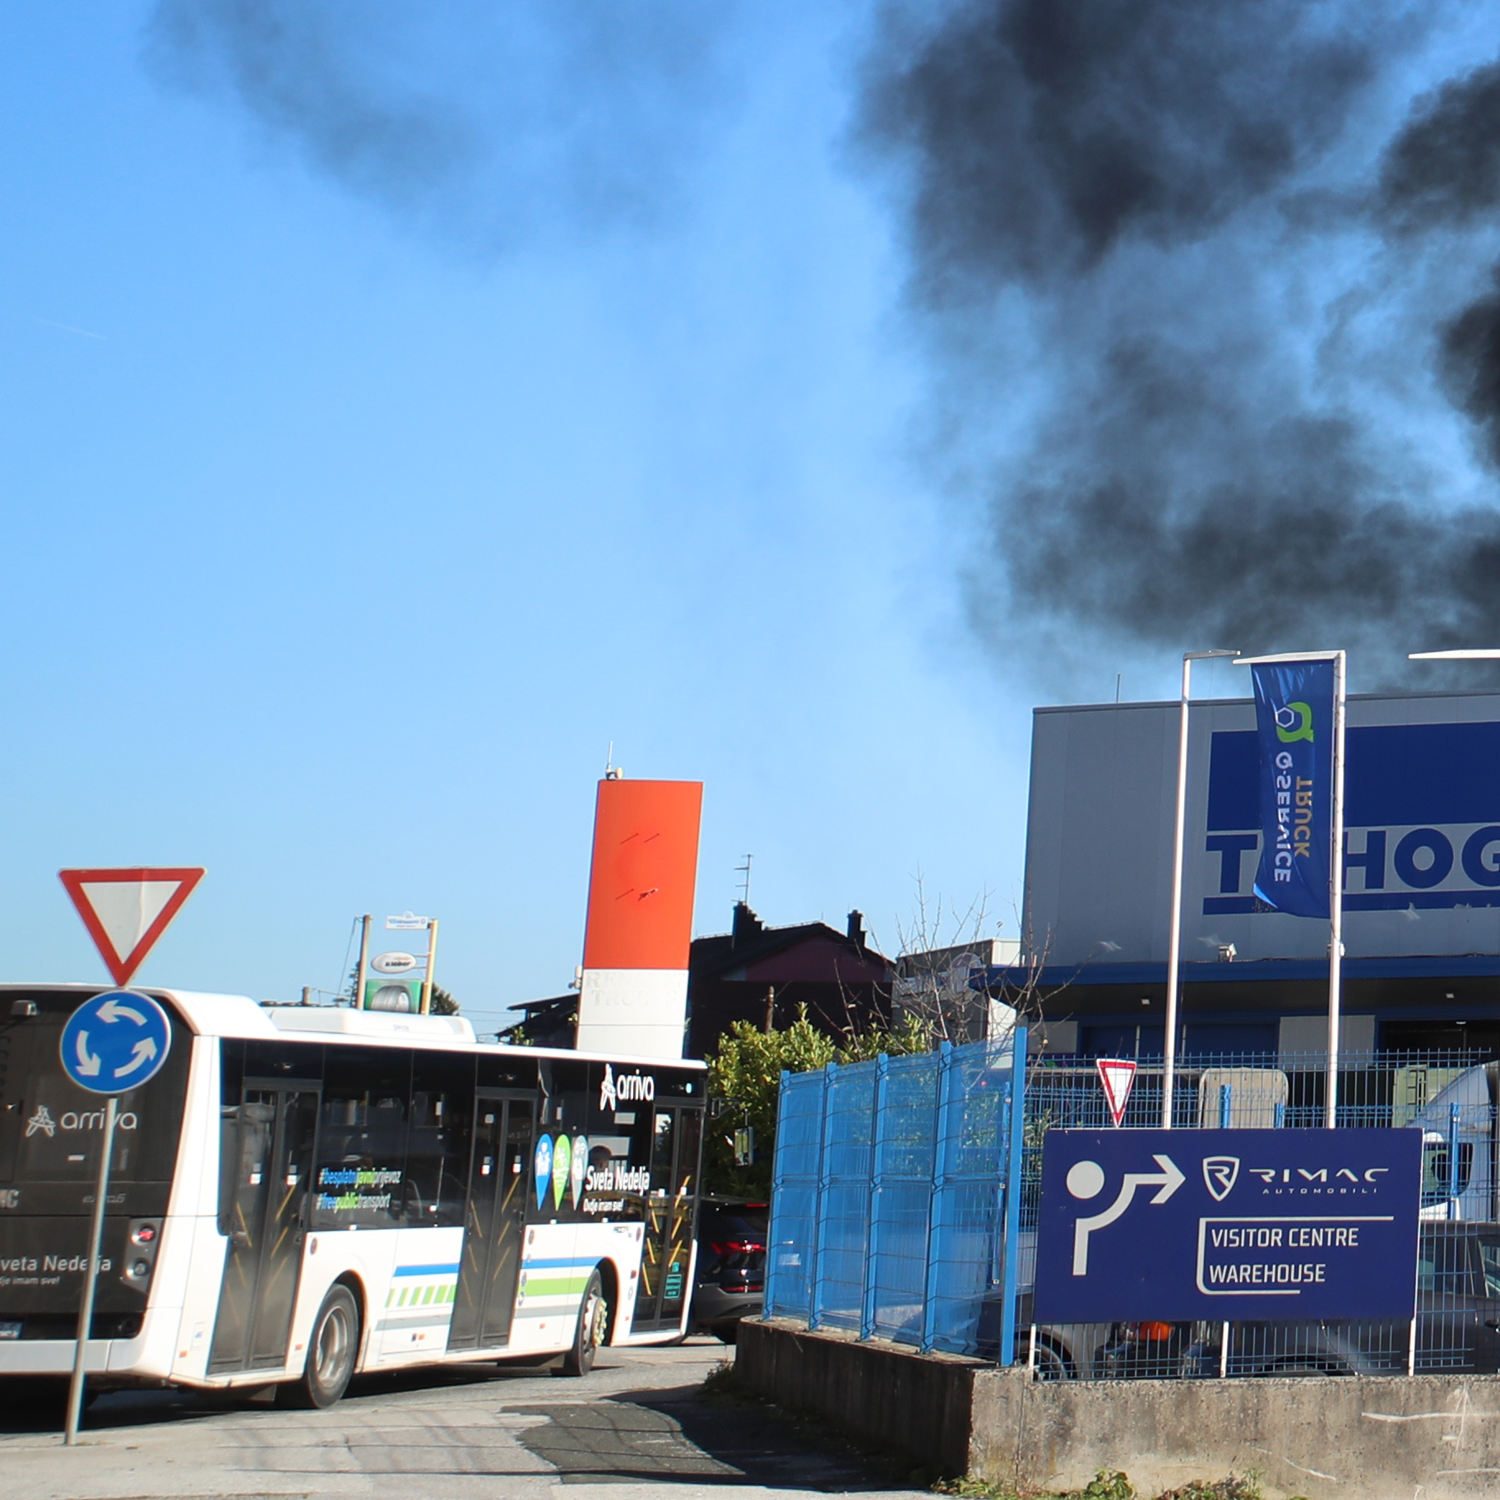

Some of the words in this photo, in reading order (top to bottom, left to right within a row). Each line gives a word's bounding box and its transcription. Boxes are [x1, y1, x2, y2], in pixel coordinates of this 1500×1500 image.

[617, 1069, 655, 1101] arriva
[585, 1165, 613, 1191] Sveta
[615, 1166, 650, 1196] Nedelja
[1249, 1167, 1390, 1183] RIMAC
[1262, 1187, 1378, 1195] AUTOMOBILI
[1211, 1228, 1283, 1248] VISITOR
[1288, 1227, 1360, 1247] CENTRE
[1209, 1263, 1327, 1284] WAREHOUSE
